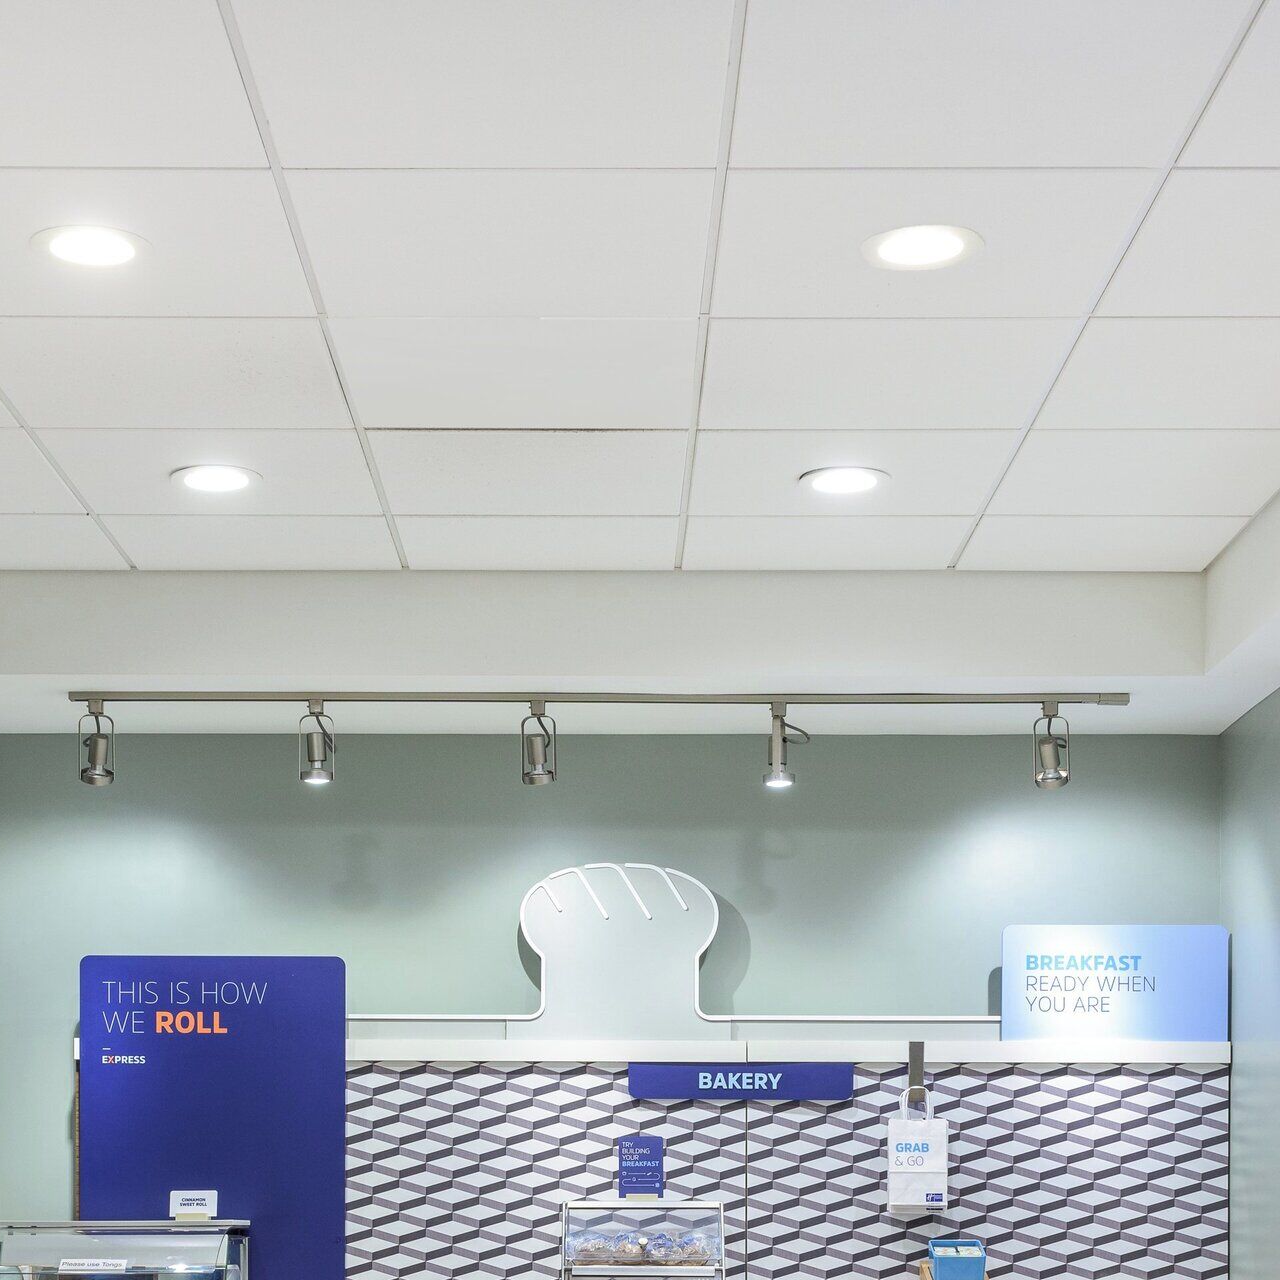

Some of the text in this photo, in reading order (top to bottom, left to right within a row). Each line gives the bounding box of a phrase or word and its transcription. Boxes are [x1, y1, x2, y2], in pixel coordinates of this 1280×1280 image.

[1025, 954, 1142, 971] BREAKFAST
[1026, 975, 1156, 992] READY WHEN
[102, 981, 268, 1005] THIS IS HOW
[1025, 995, 1110, 1012] YOU ARE
[102, 1010, 228, 1034] WE ROLL
[102, 1055, 146, 1064] EXPRESS
[698, 1072, 783, 1090] BAKERY
[895, 1143, 930, 1153] GRAB
[895, 1156, 924, 1166] & GO
